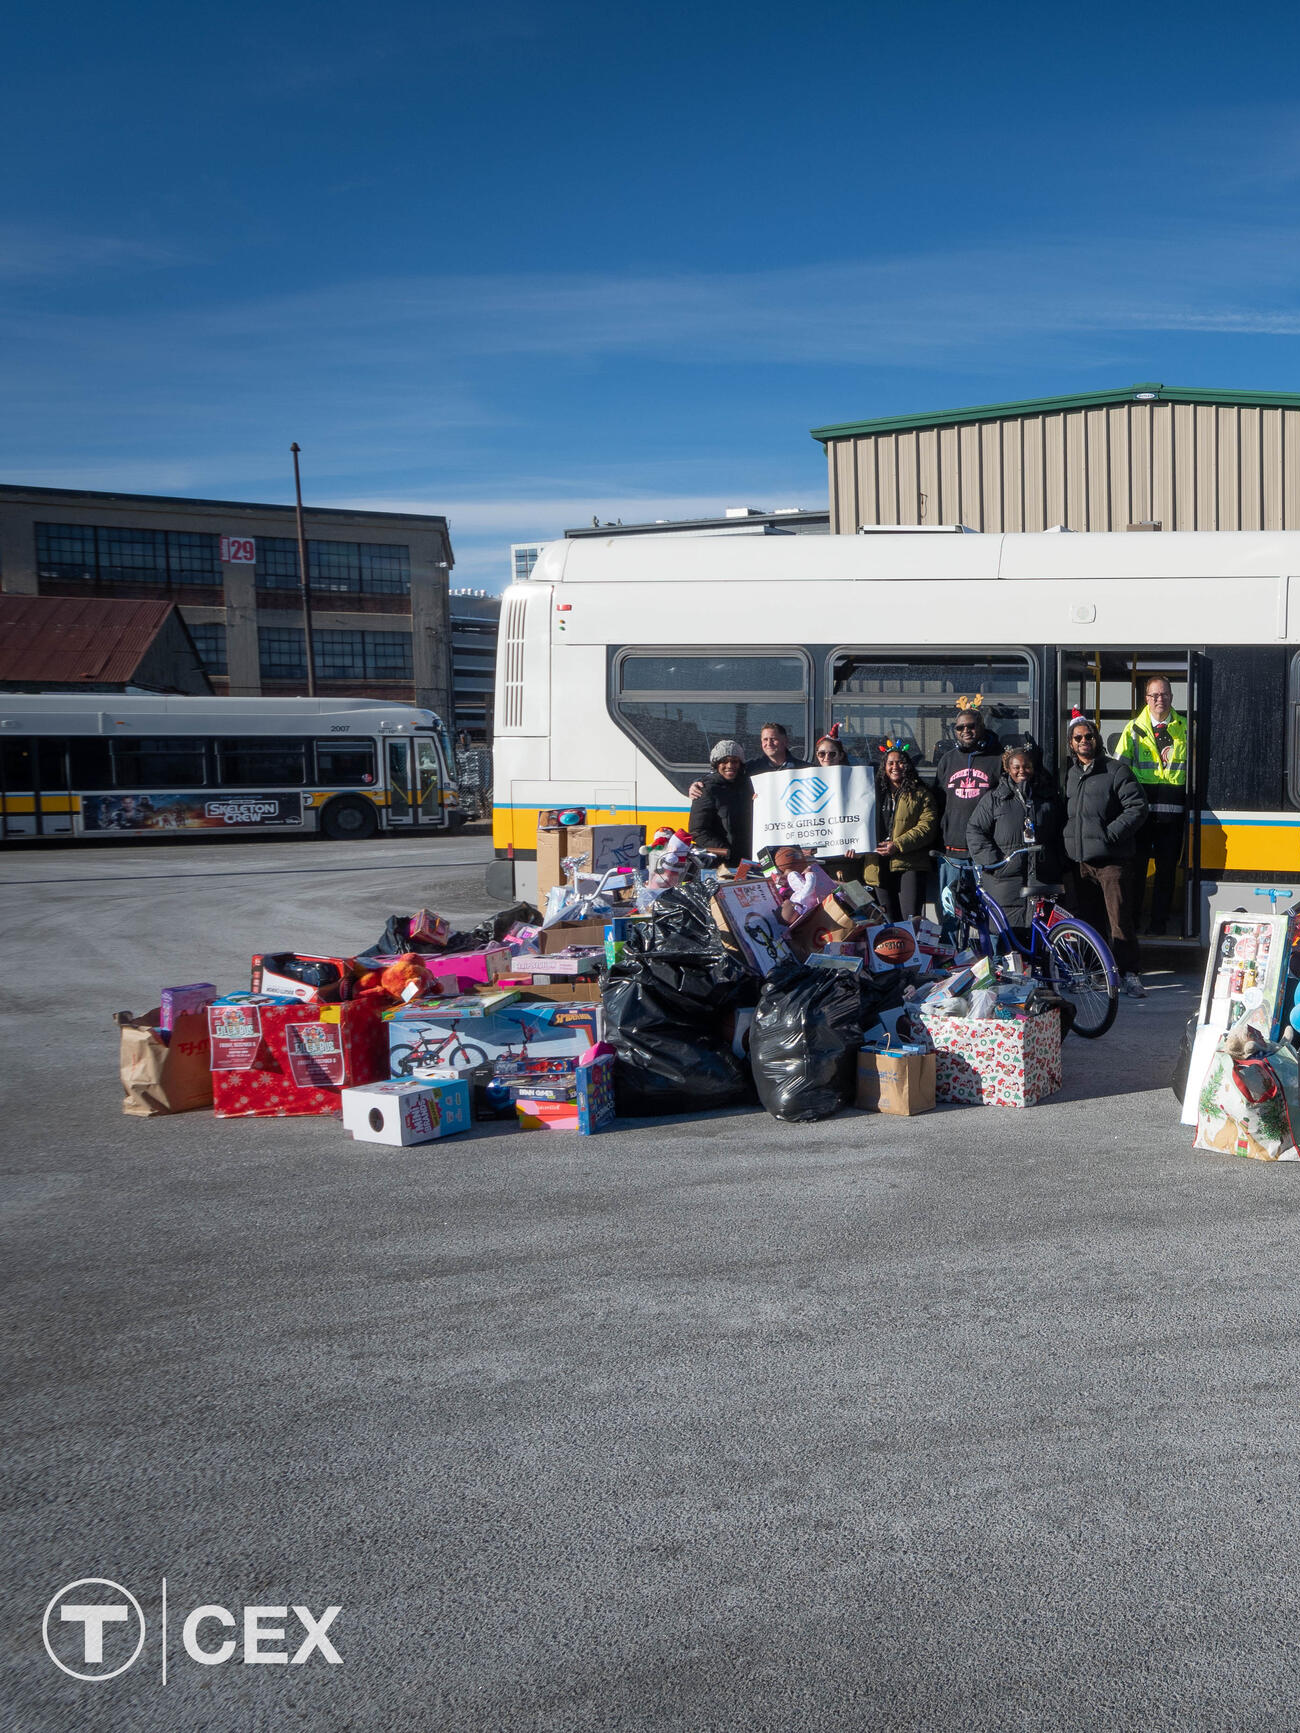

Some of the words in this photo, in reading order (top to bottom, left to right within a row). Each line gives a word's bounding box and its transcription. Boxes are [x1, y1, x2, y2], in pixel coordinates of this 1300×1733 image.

[231, 539, 255, 561] 29
[330, 725, 351, 733] 2007
[949, 769, 970, 783] STREET
[972, 768, 989, 782] WEAR
[955, 788, 980, 799] CULTURE
[209, 803, 275, 815] SKELETON
[224, 812, 261, 824] CREW
[787, 821, 795, 829] &
[795, 817, 826, 828] GIRLS
[828, 814, 860, 826] CLUBS
[786, 832, 795, 840] OF
[797, 828, 834, 839] BOSTON
[824, 837, 860, 847] ROXBURY
